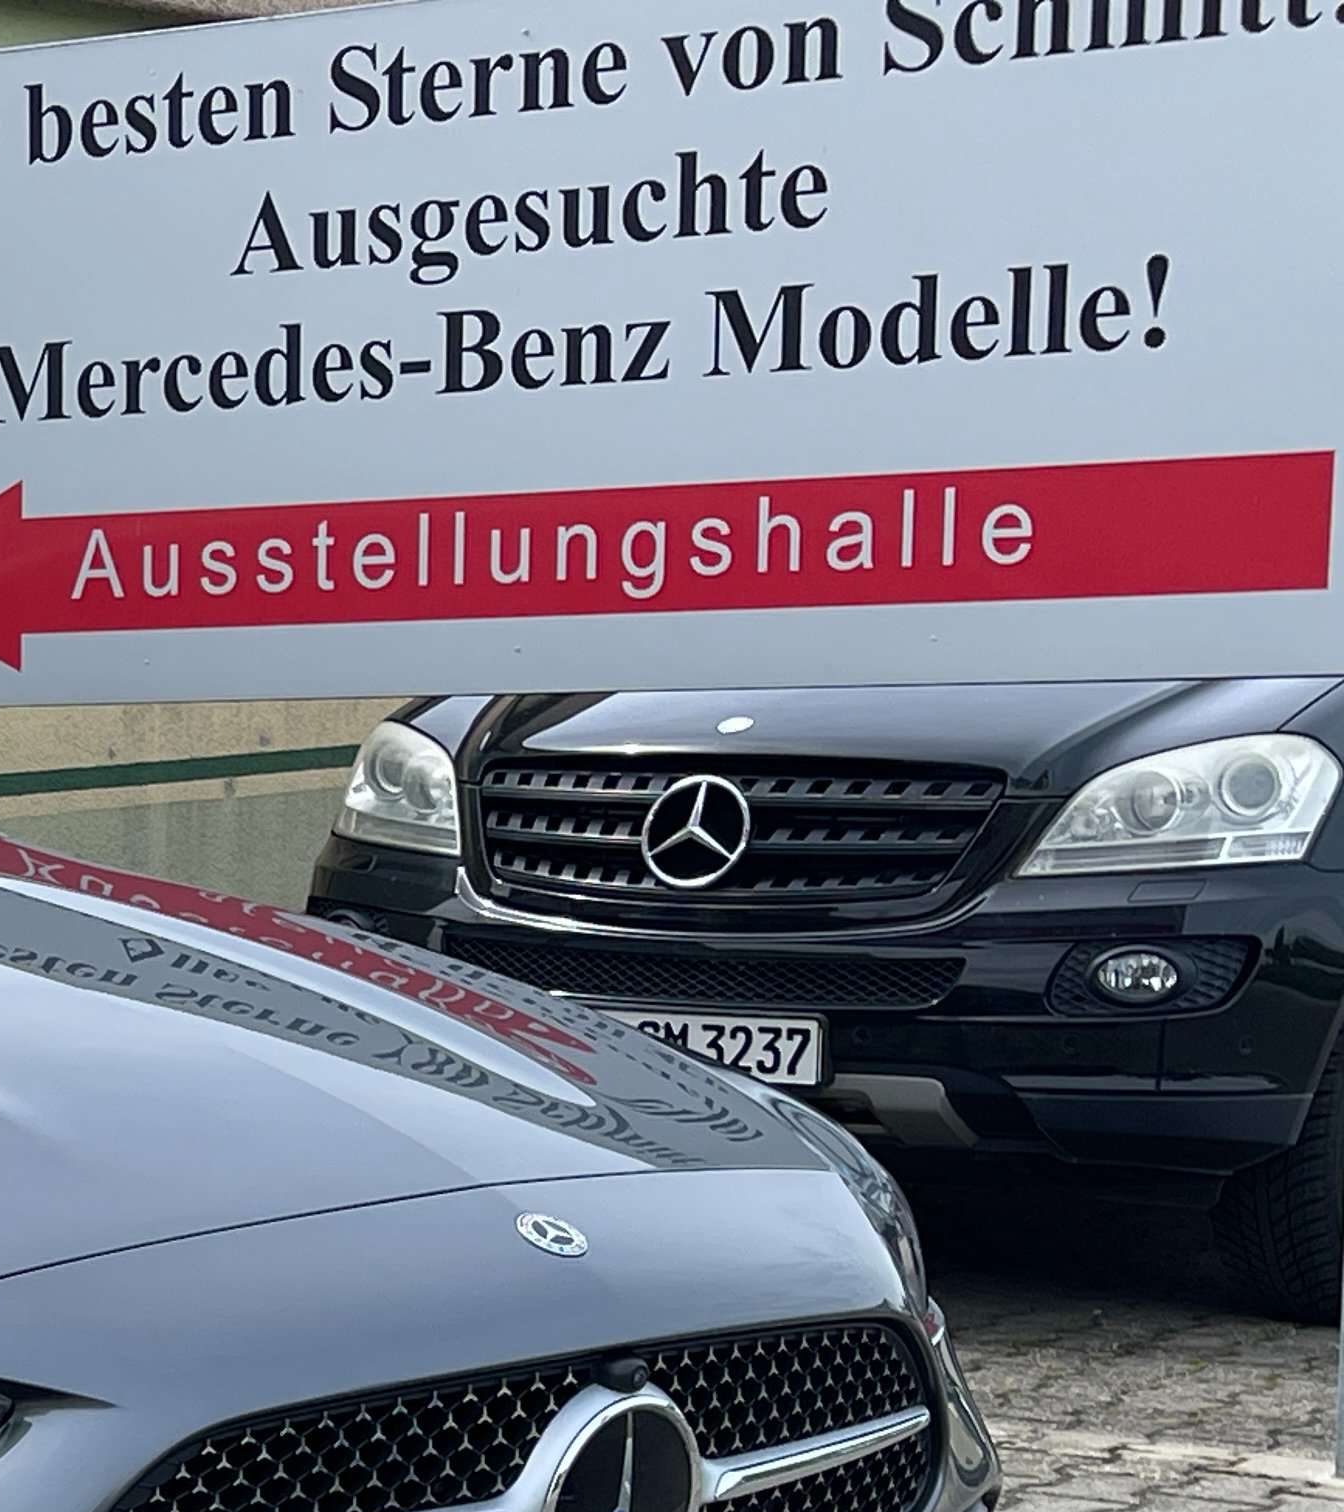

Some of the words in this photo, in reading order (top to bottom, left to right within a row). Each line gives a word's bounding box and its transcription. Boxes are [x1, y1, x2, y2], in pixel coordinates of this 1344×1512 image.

[23, 72, 296, 166] besten
[329, 42, 627, 134] Sterne
[660, 17, 843, 98] von
[229, 149, 829, 288] Ausgesuchte
[702, 254, 1170, 378] Modelle!
[70, 485, 1036, 601] Ausstellungshalle
[700, 1023, 812, 1076] 3237
